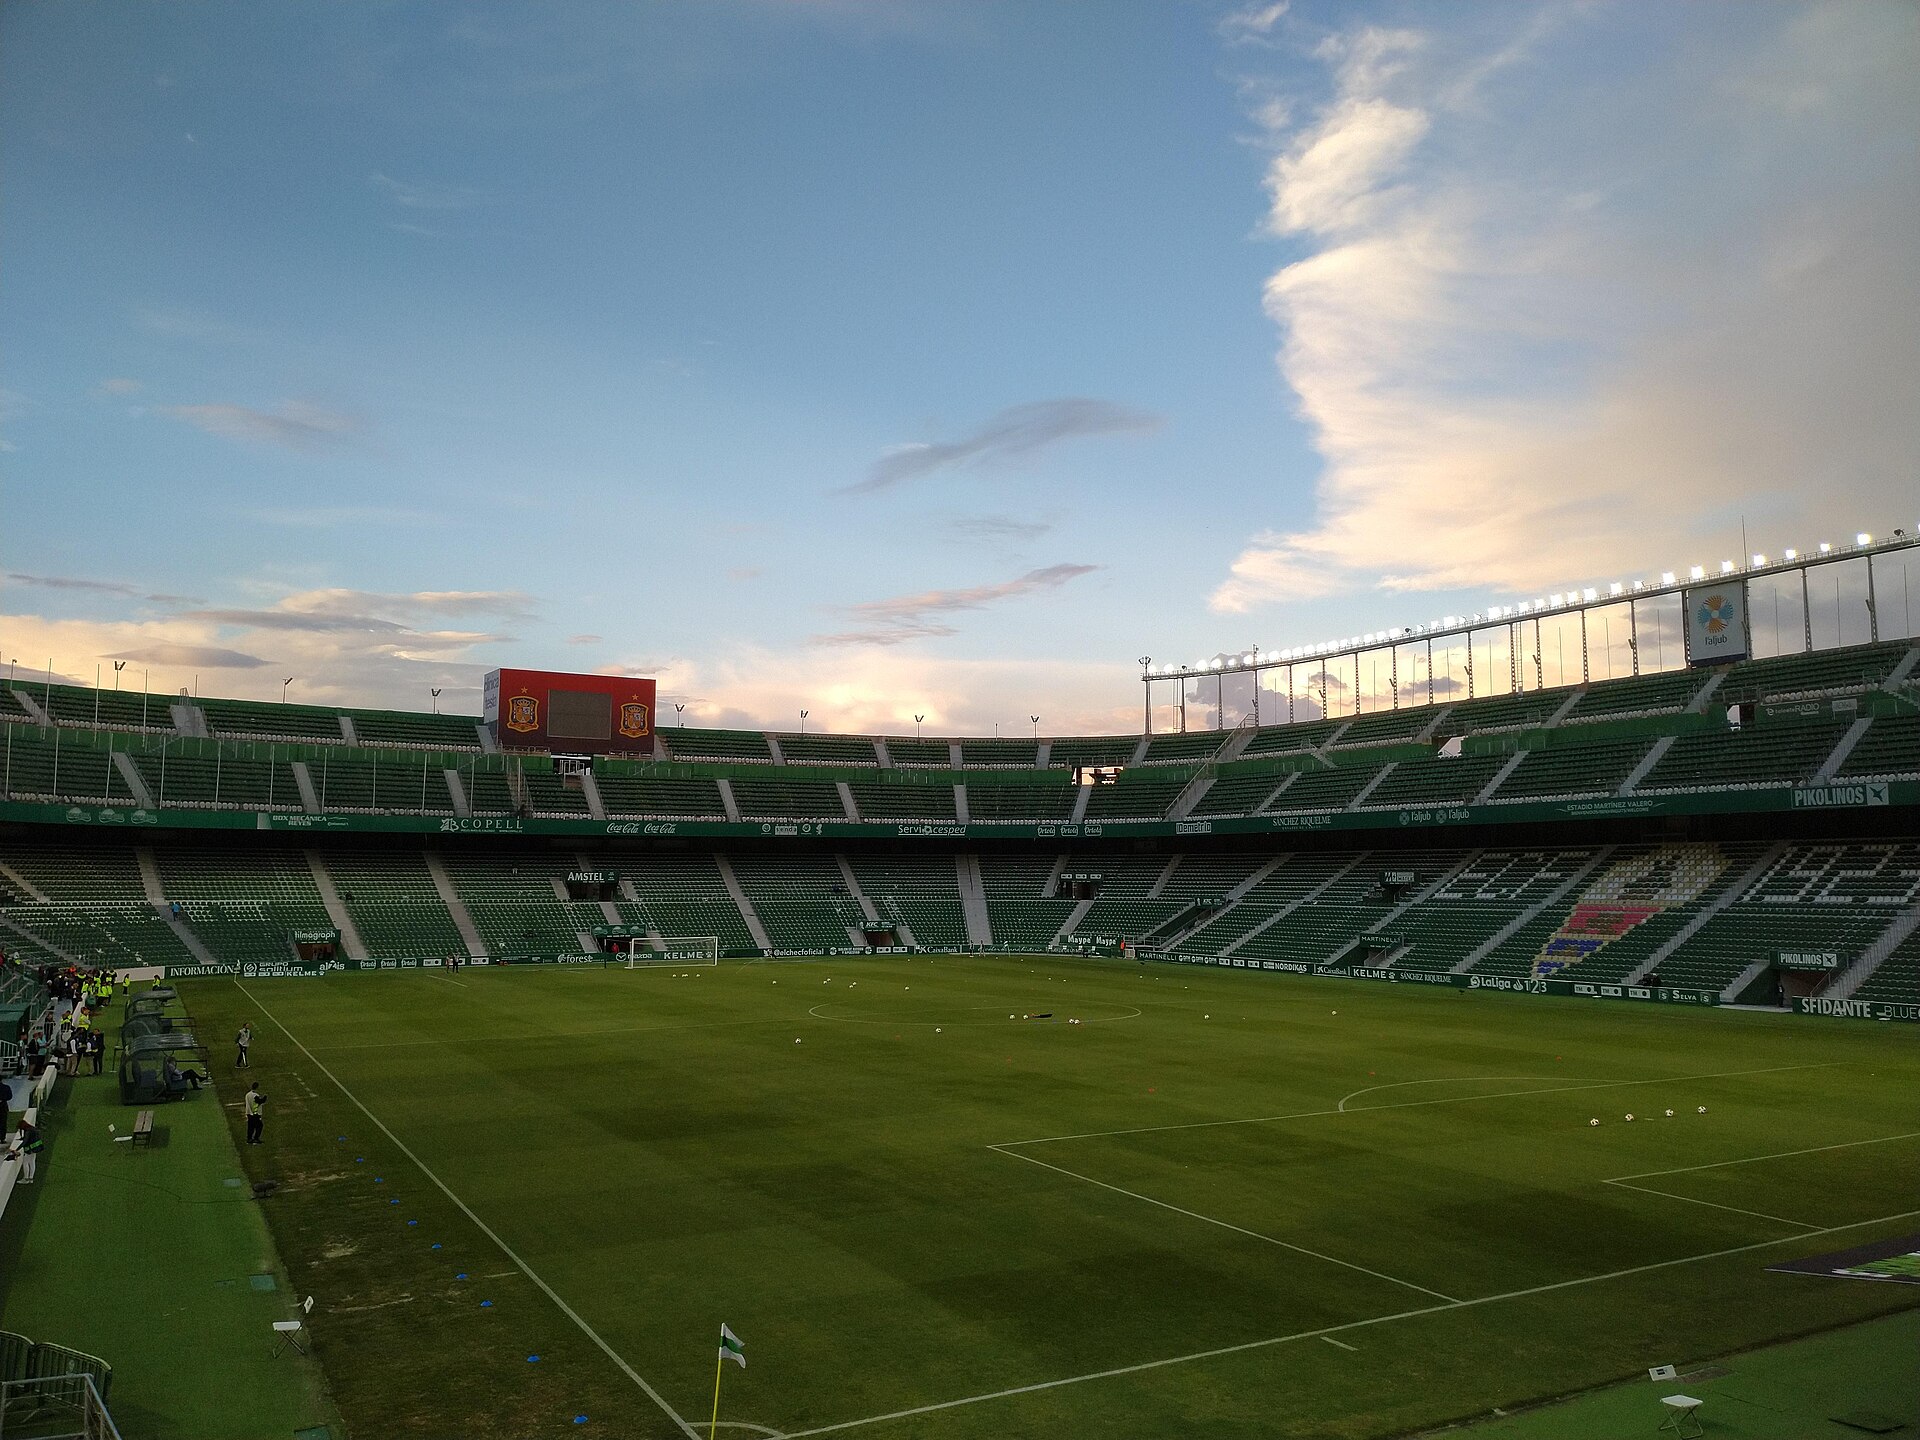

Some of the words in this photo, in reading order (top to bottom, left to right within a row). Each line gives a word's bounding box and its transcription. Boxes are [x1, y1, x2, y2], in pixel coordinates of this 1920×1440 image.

[1795, 703, 1820, 712] RADIO
[1794, 786, 1864, 806] PIKOLINOS
[1567, 803, 1593, 811] ESTADIO
[1594, 801, 1626, 809] MARTÍNEZ
[461, 819, 523, 829] COPELL
[1272, 816, 1298, 826] SÁNCHEZ
[1300, 815, 1331, 827] RIQUELME
[606, 823, 640, 834] Coca-Cola
[644, 823, 677, 834] Coca-Cola
[567, 872, 604, 881] AMSTEL
[774, 948, 824, 956] @elchecfoficial
[1139, 952, 1176, 961] MARTINELLI
[567, 954, 593, 963] forest
[1780, 952, 1822, 964] PIKOLINOS
[170, 964, 234, 977] INFORMACIÓN
[1275, 962, 1307, 972] NORDIKAS
[1353, 968, 1387, 979] KELME
[1400, 971, 1424, 981] SÁNCHEZ
[1481, 976, 1511, 990] LaLiga
[1801, 998, 1871, 1018] SFIDANTE
